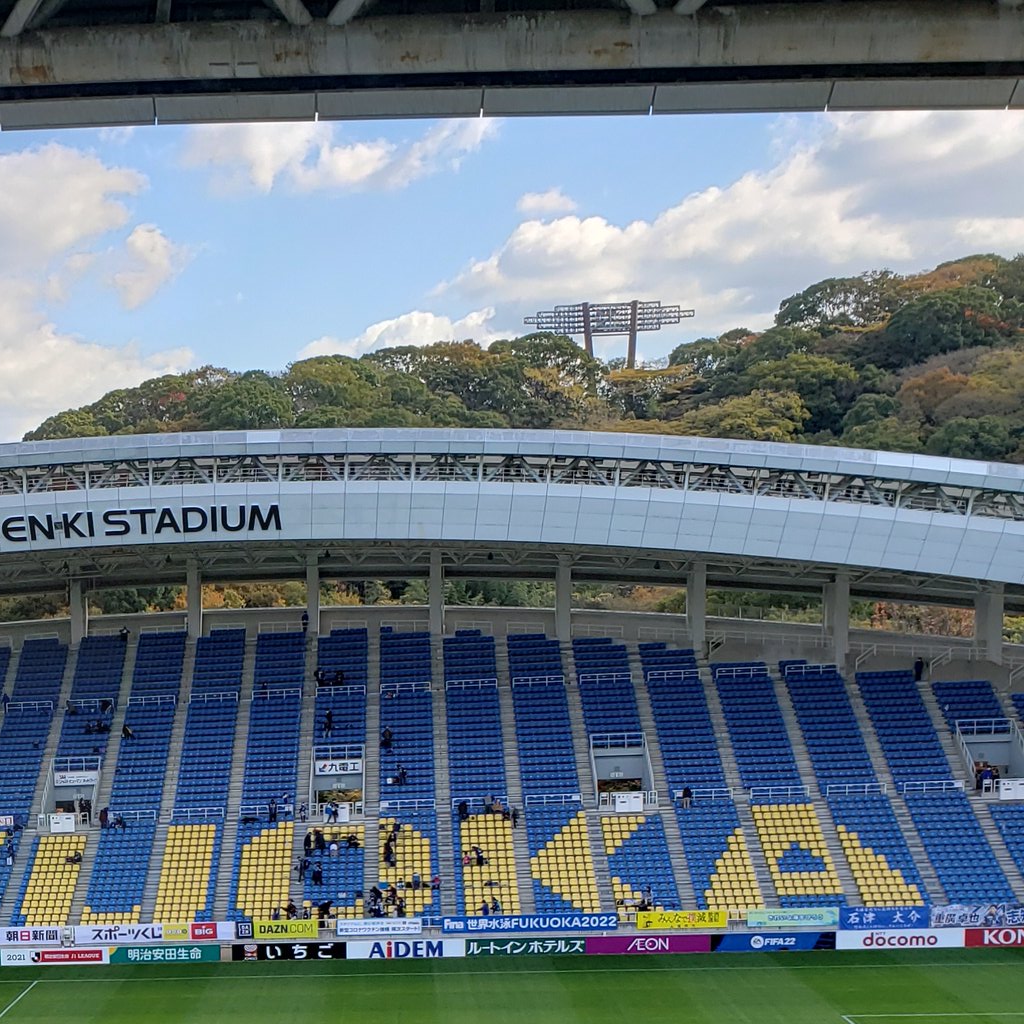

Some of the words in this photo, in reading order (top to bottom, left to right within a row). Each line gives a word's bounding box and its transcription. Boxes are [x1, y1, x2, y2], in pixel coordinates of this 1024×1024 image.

[103, 504, 282, 536] STADIUM
[328, 762, 359, 772] 九電工
[847, 912, 876, 924] 石津
[892, 910, 921, 923] 大介
[6, 930, 58, 941] 朝日新聞
[92, 926, 162, 940] スポーツくじ
[259, 923, 314, 934] DAZN.COM
[863, 932, 938, 946] docomo
[128, 948, 202, 961] 明治安田生命
[266, 943, 334, 959] いちご
